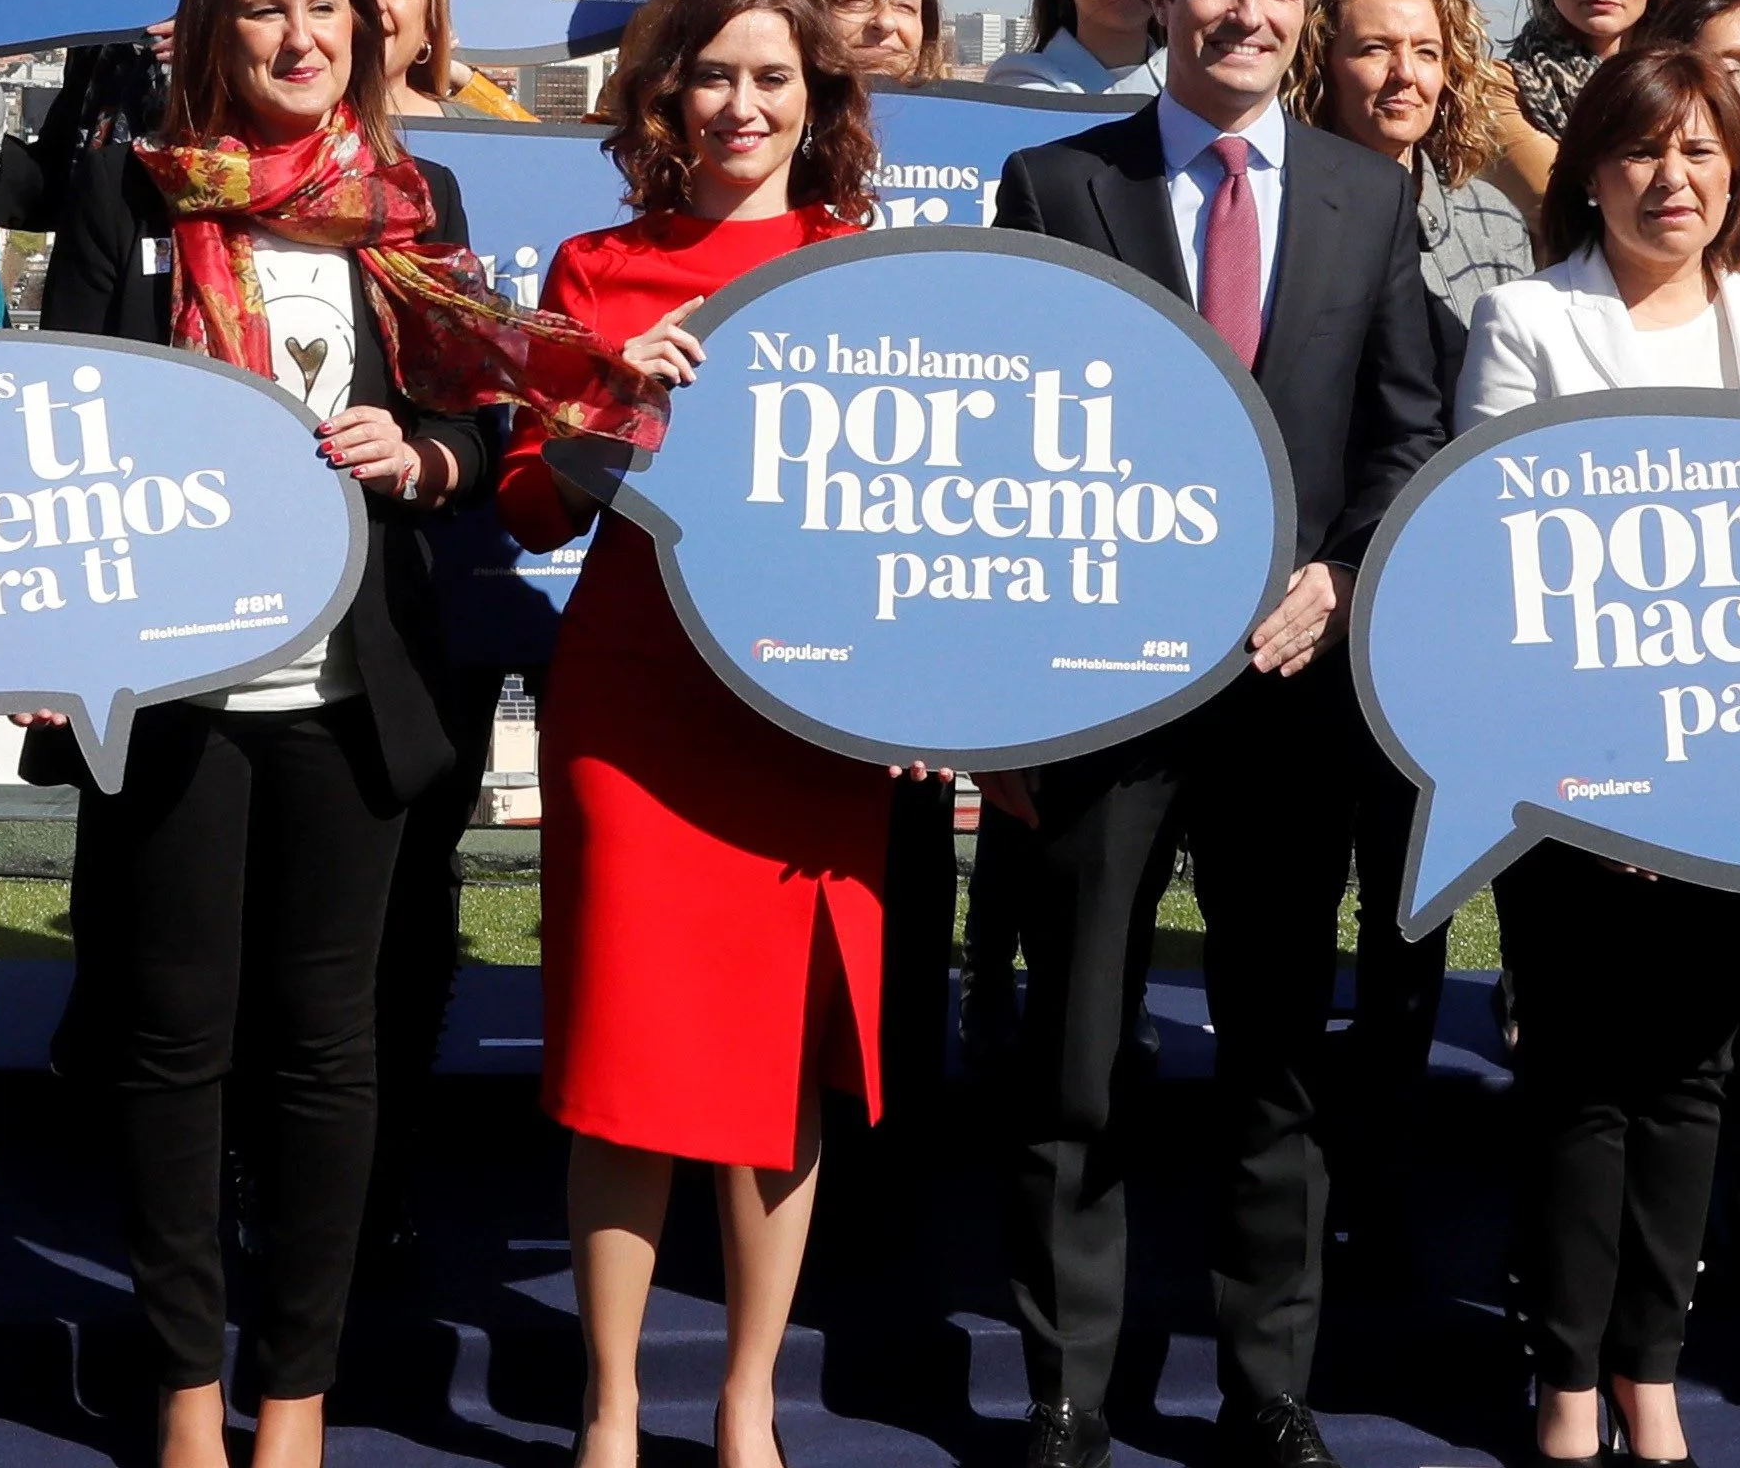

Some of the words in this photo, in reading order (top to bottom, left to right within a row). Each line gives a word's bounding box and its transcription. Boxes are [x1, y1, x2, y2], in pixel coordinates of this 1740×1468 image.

[747, 330, 817, 373] No
[826, 333, 1030, 382] hablamos
[14, 365, 134, 485] ti,
[745, 380, 996, 504] por
[1026, 360, 1133, 482] ti,
[1493, 454, 1571, 500] No
[800, 456, 1219, 546] hacemos
[80, 538, 139, 604] ti
[875, 549, 1051, 620] para
[1068, 542, 1120, 605] ti
[139, 614, 289, 641] #NoHablamosHacemos
[234, 594, 283, 616] #8M
[762, 641, 850, 663] populares
[1051, 656, 1191, 673] #NoHablamosHacemos
[1142, 641, 1188, 658] #8M
[1566, 777, 1652, 801] populares
